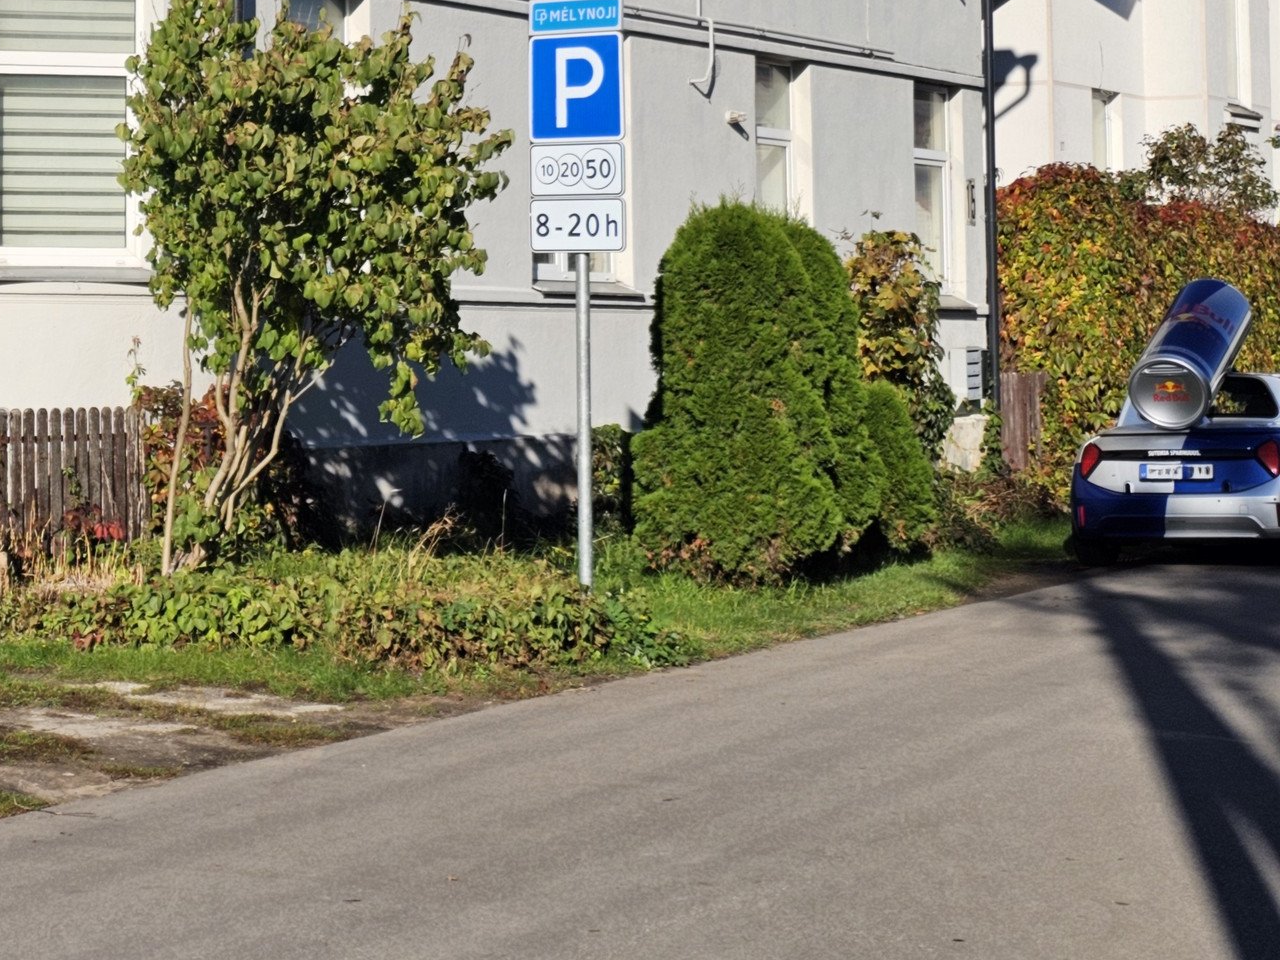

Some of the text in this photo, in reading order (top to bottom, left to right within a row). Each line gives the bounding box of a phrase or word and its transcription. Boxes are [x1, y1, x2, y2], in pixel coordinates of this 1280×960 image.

[549, 6, 617, 23] MĖLYNOJI
[555, 46, 605, 129] P
[541, 158, 612, 179] 10 20 50
